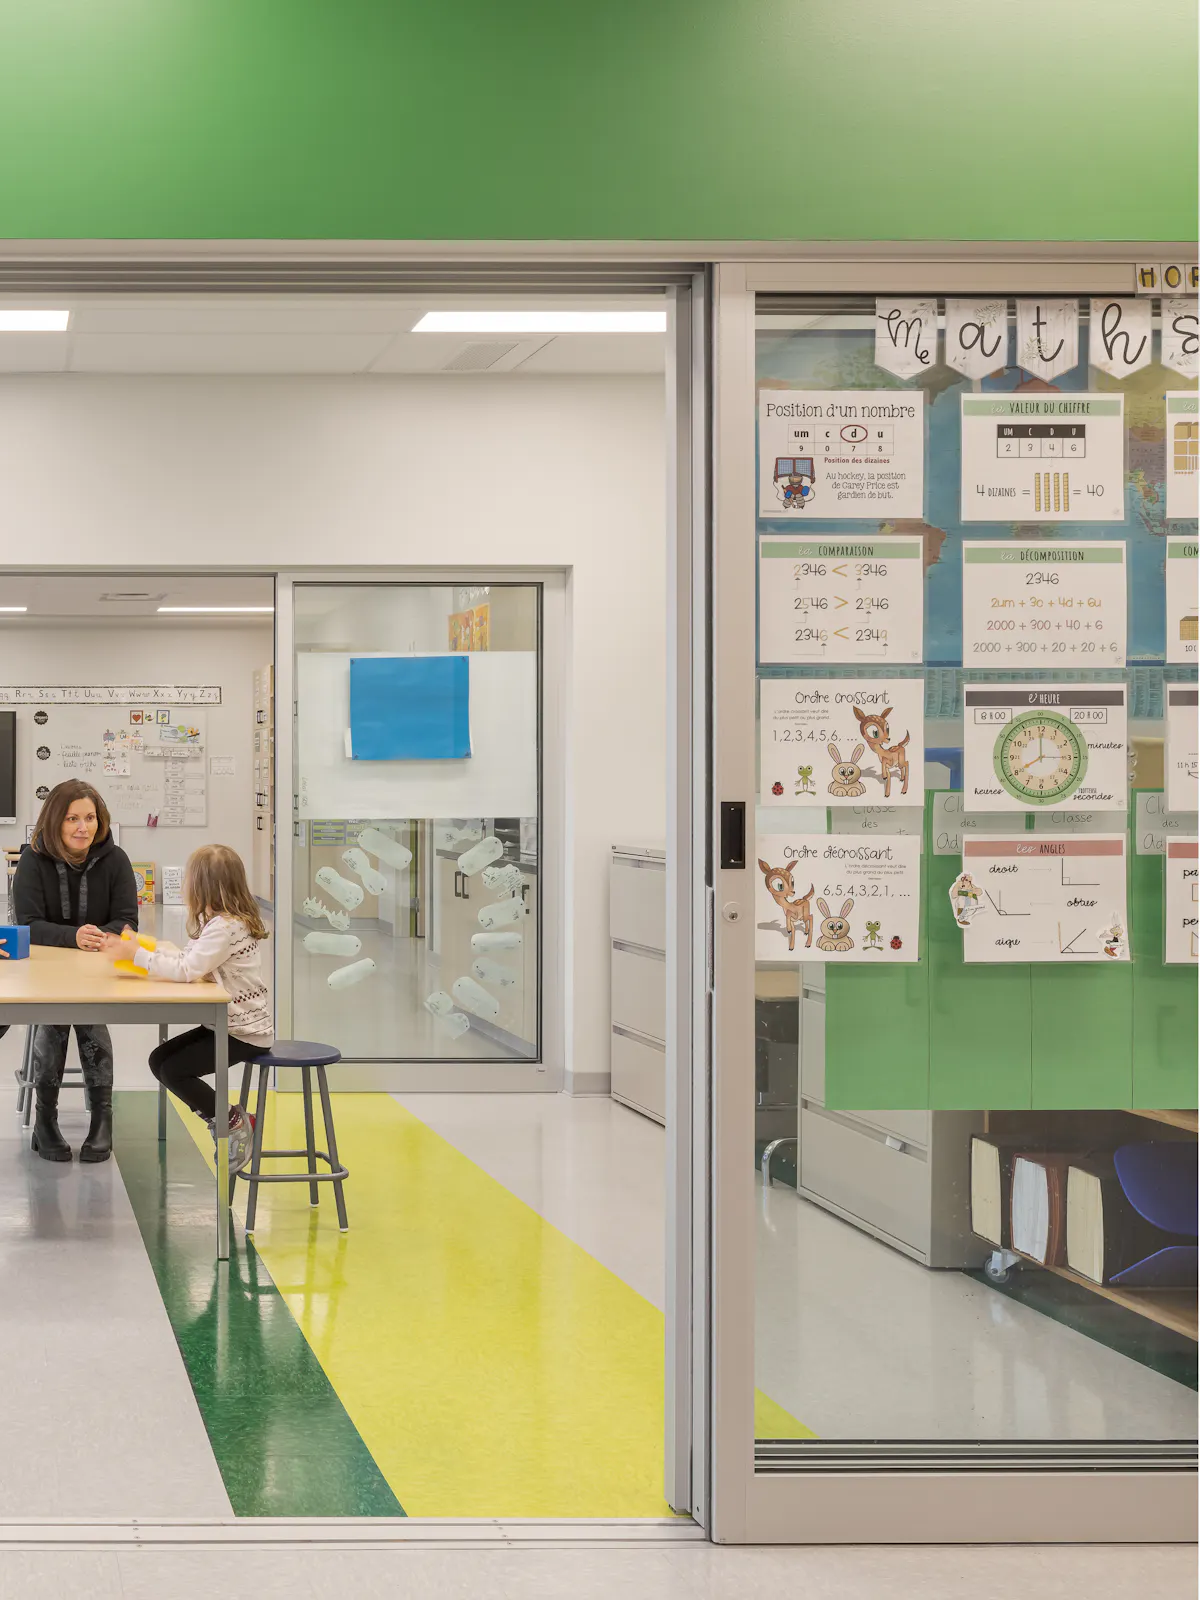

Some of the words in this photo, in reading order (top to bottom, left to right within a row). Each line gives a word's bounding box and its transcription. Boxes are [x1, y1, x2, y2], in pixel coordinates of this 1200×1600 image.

[766, 403, 823, 418] Position
[826, 404, 857, 418] d'un
[862, 404, 915, 418] nombre
[1009, 402, 1040, 413] VALEUR
[1044, 402, 1054, 413] DU
[1059, 402, 1090, 413] CHIFFRE
[851, 429, 857, 438] d
[838, 472, 866, 481] hockey,
[877, 472, 906, 481] position
[837, 491, 866, 500] gardien
[976, 484, 985, 496] 4
[988, 487, 1016, 497] DIZAINES
[1087, 484, 1104, 497] 40
[818, 546, 874, 556] COMPARAISON
[1020, 549, 1084, 561] DÉCOMPOSITION
[794, 563, 827, 577] 2346
[855, 563, 887, 577] 3346
[1026, 572, 1060, 584] 2346
[794, 597, 828, 610] 2546
[856, 597, 889, 610] 2346
[991, 597, 1015, 608] 2um
[1030, 596, 1044, 608] 3c
[1058, 597, 1073, 608] 4d
[1087, 597, 1101, 608] 6u
[987, 620, 1015, 630] 2000
[1030, 619, 1051, 630] 300
[1066, 619, 1081, 630] 40
[1095, 620, 1103, 630] 6
[795, 628, 828, 641] 2346
[856, 628, 888, 641] 2349
[973, 642, 1001, 653] 2000
[1016, 642, 1037, 653] 300
[1052, 642, 1066, 653] 20
[1081, 642, 1095, 653] 20
[1110, 642, 1118, 652] 6
[795, 690, 829, 704] Ordre
[835, 690, 890, 705] croissant
[981, 712, 987, 720] 8
[995, 712, 1005, 720] 00
[943, 796, 964, 813] Cl
[862, 818, 878, 828] des
[960, 817, 976, 828] des
[1162, 819, 1179, 827] des
[784, 845, 818, 858] Ordre
[824, 845, 893, 860] décroissant
[1040, 844, 1066, 854] ANGLES
[989, 864, 1019, 873] droit
[1067, 898, 1097, 907] obtus
